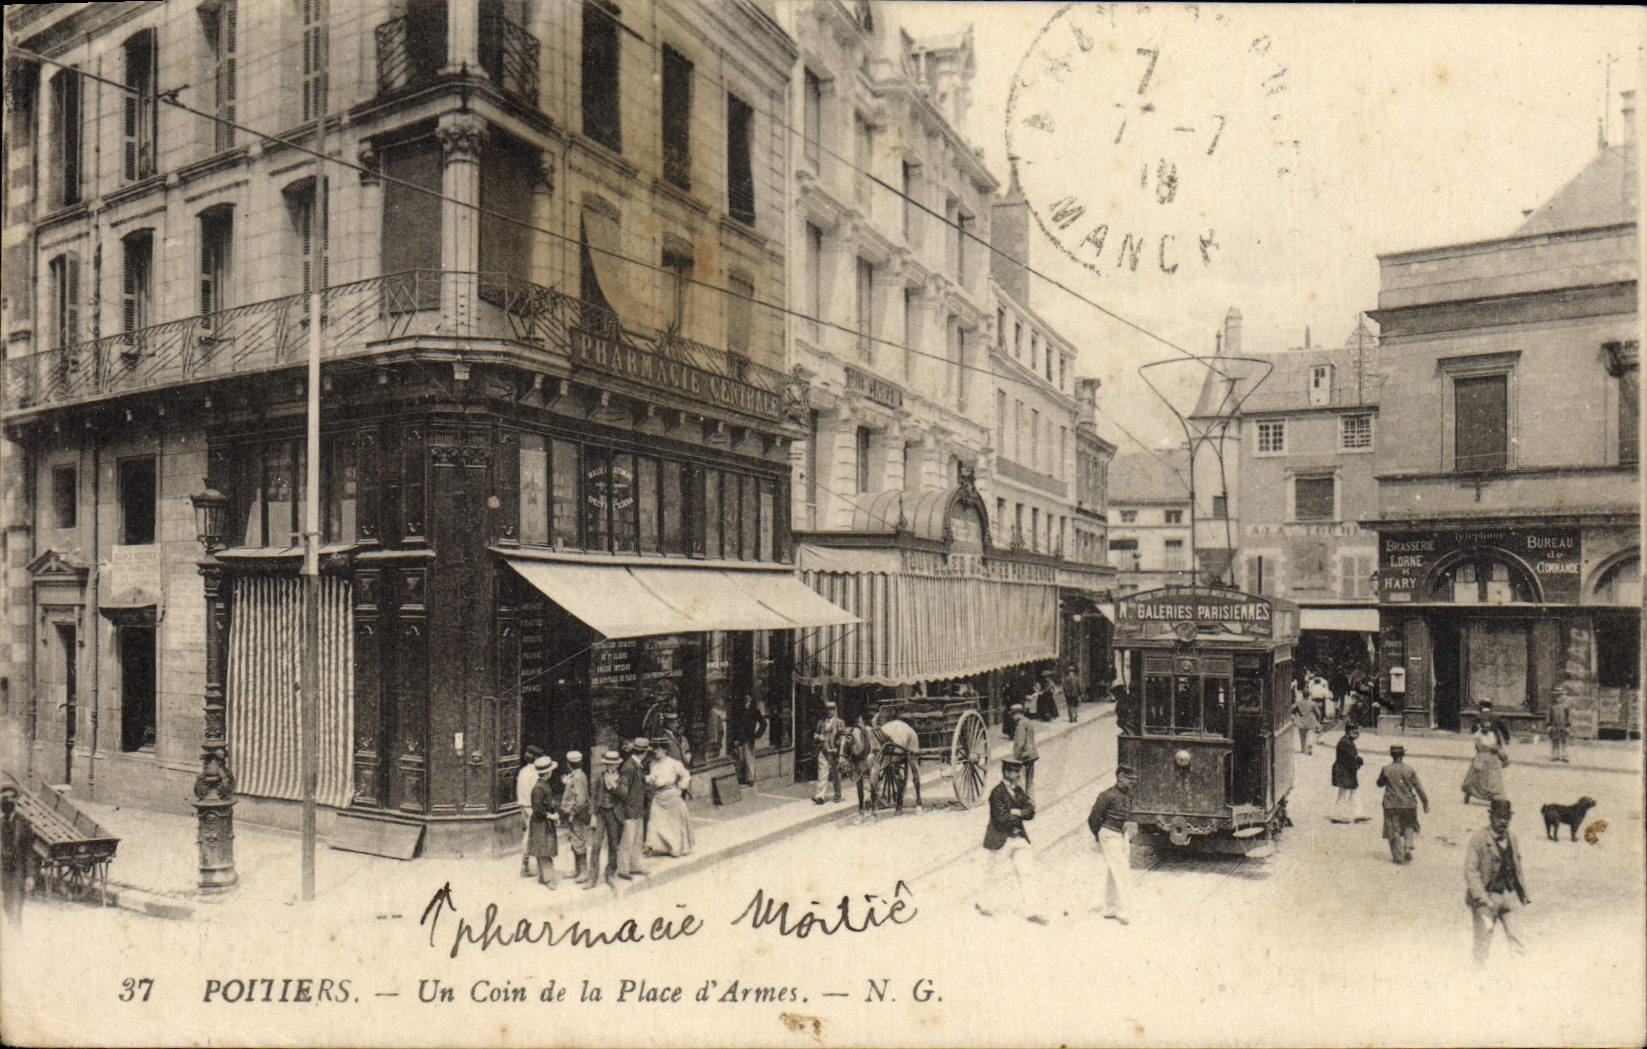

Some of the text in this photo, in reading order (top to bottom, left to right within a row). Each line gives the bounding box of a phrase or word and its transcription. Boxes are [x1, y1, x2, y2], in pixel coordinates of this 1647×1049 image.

[581, 334, 701, 394] PHARMACIE
[1385, 540, 1436, 552] BRASSERIE
[1526, 534, 1574, 549] BUREAU
[1137, 602, 1193, 620] GALERIES
[1197, 602, 1271, 621] PARISIENNES
